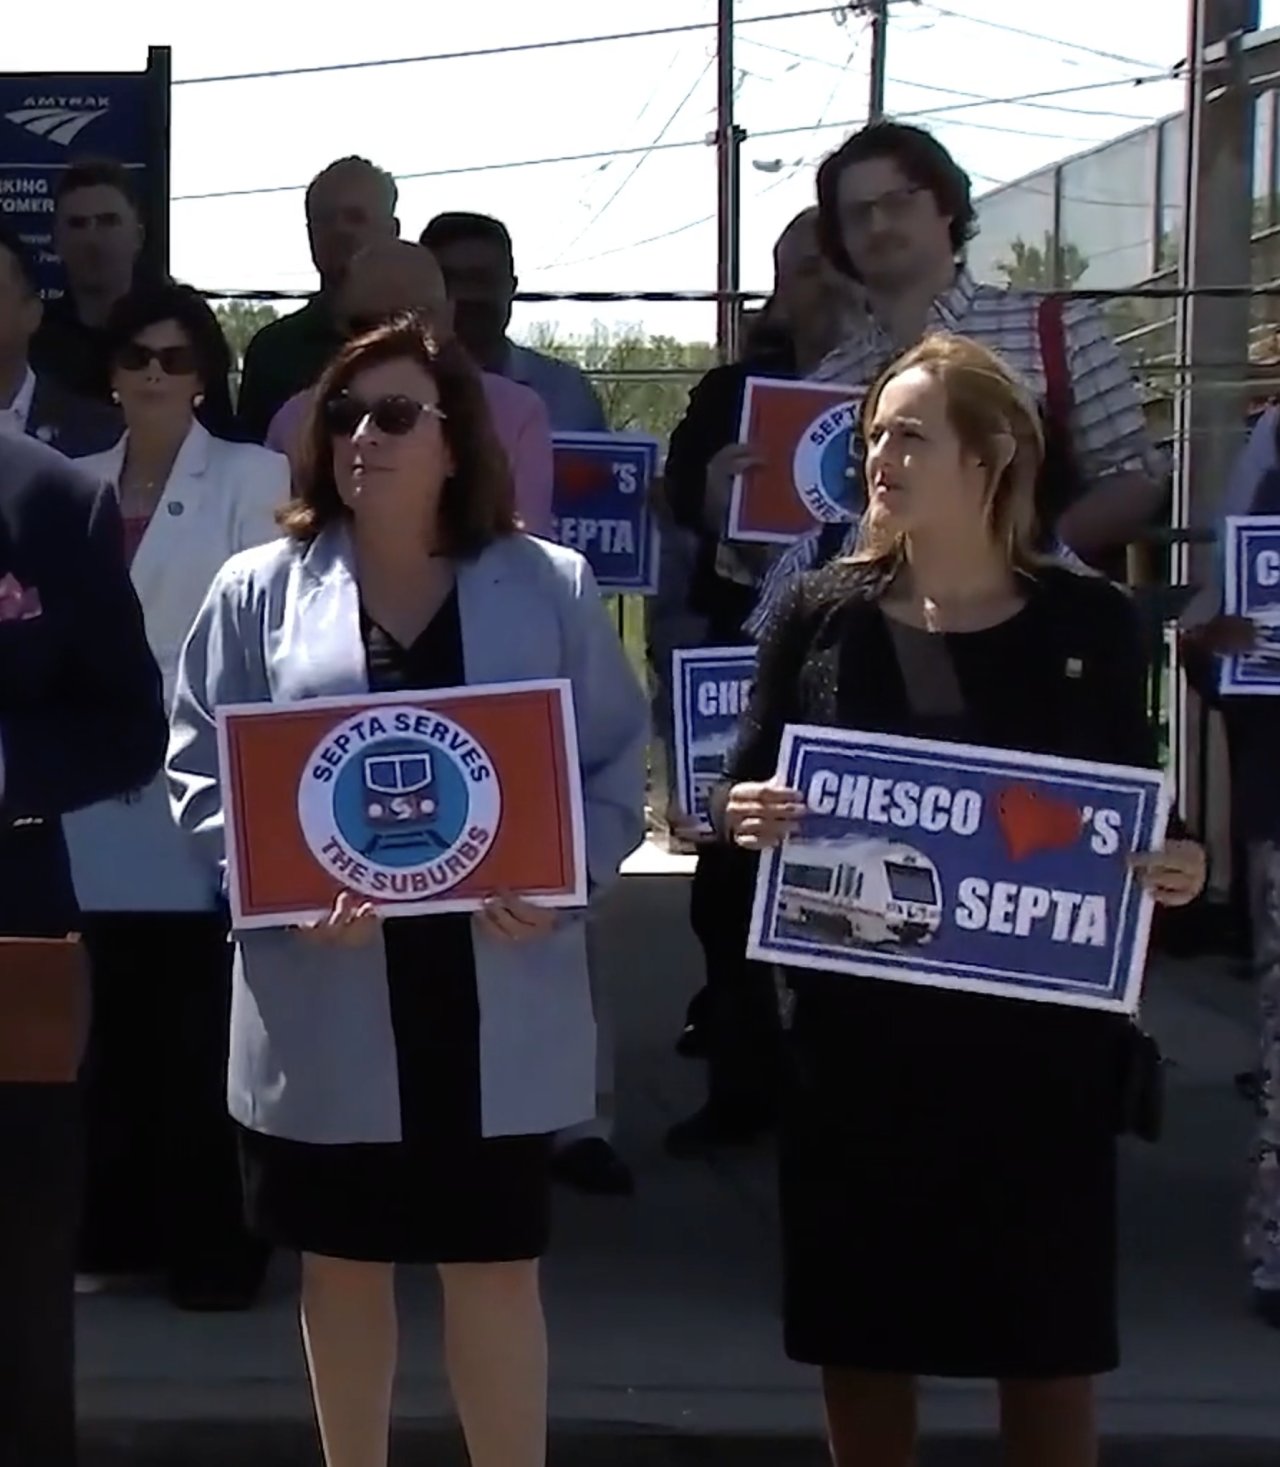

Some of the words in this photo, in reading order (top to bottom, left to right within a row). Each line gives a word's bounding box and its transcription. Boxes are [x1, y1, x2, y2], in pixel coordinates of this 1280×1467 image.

[23, 96, 110, 106] AMTRAK
[809, 404, 857, 446] SEPT
[552, 517, 634, 553] EPTA
[312, 716, 387, 783] SEPTA
[394, 712, 491, 784] SERVES
[807, 769, 982, 836] CHESCO
[321, 835, 369, 886] THE
[370, 825, 490, 894] SUBURBS
[954, 876, 1107, 946] SEPTA
